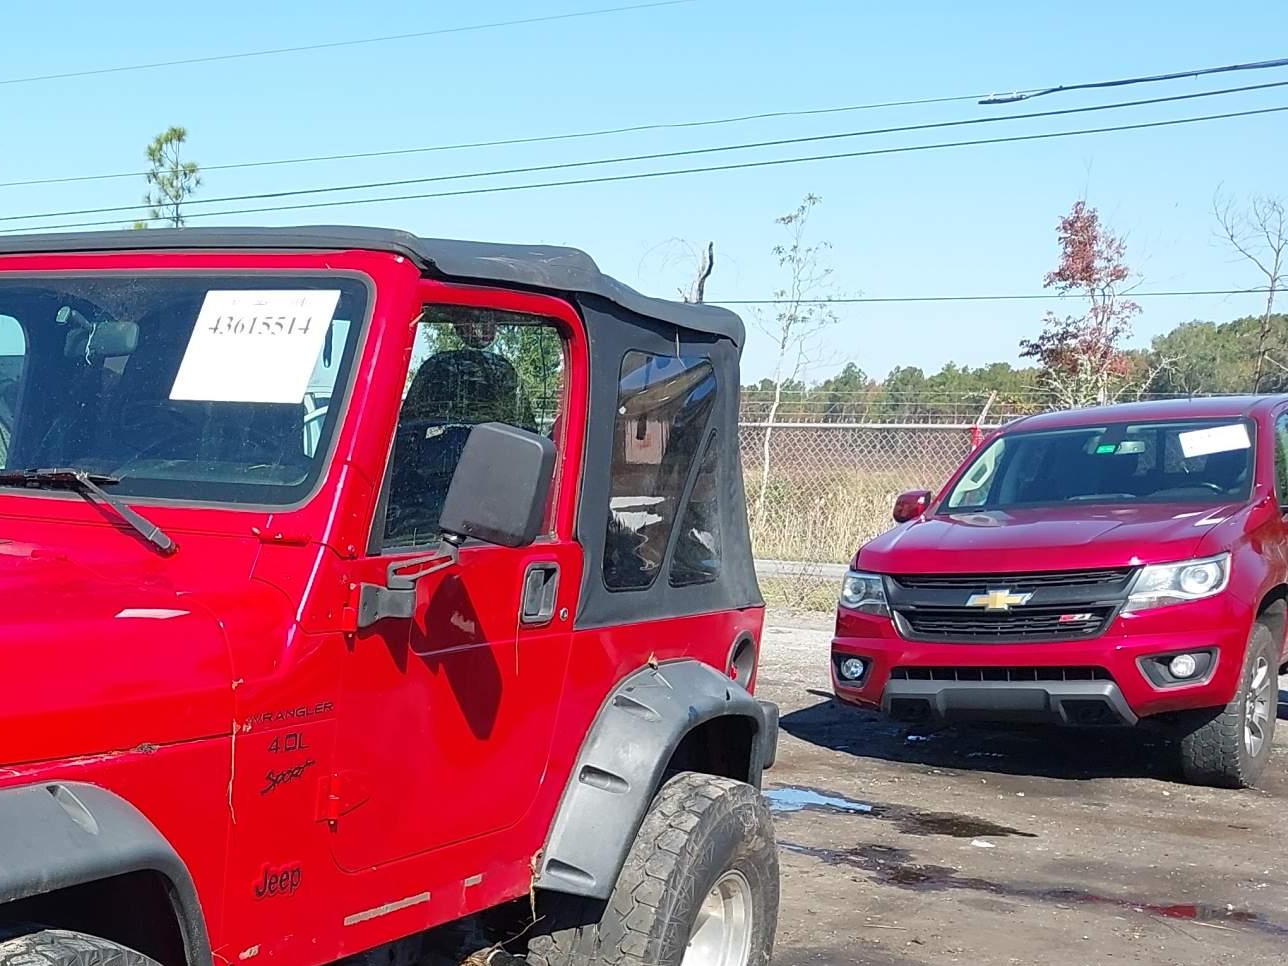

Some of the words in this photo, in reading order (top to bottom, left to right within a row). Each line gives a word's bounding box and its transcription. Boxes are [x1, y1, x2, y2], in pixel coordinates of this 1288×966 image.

[208, 315, 313, 336] 43615514
[246, 702, 334, 724] WRANGLER
[255, 867, 302, 897] Jeep
